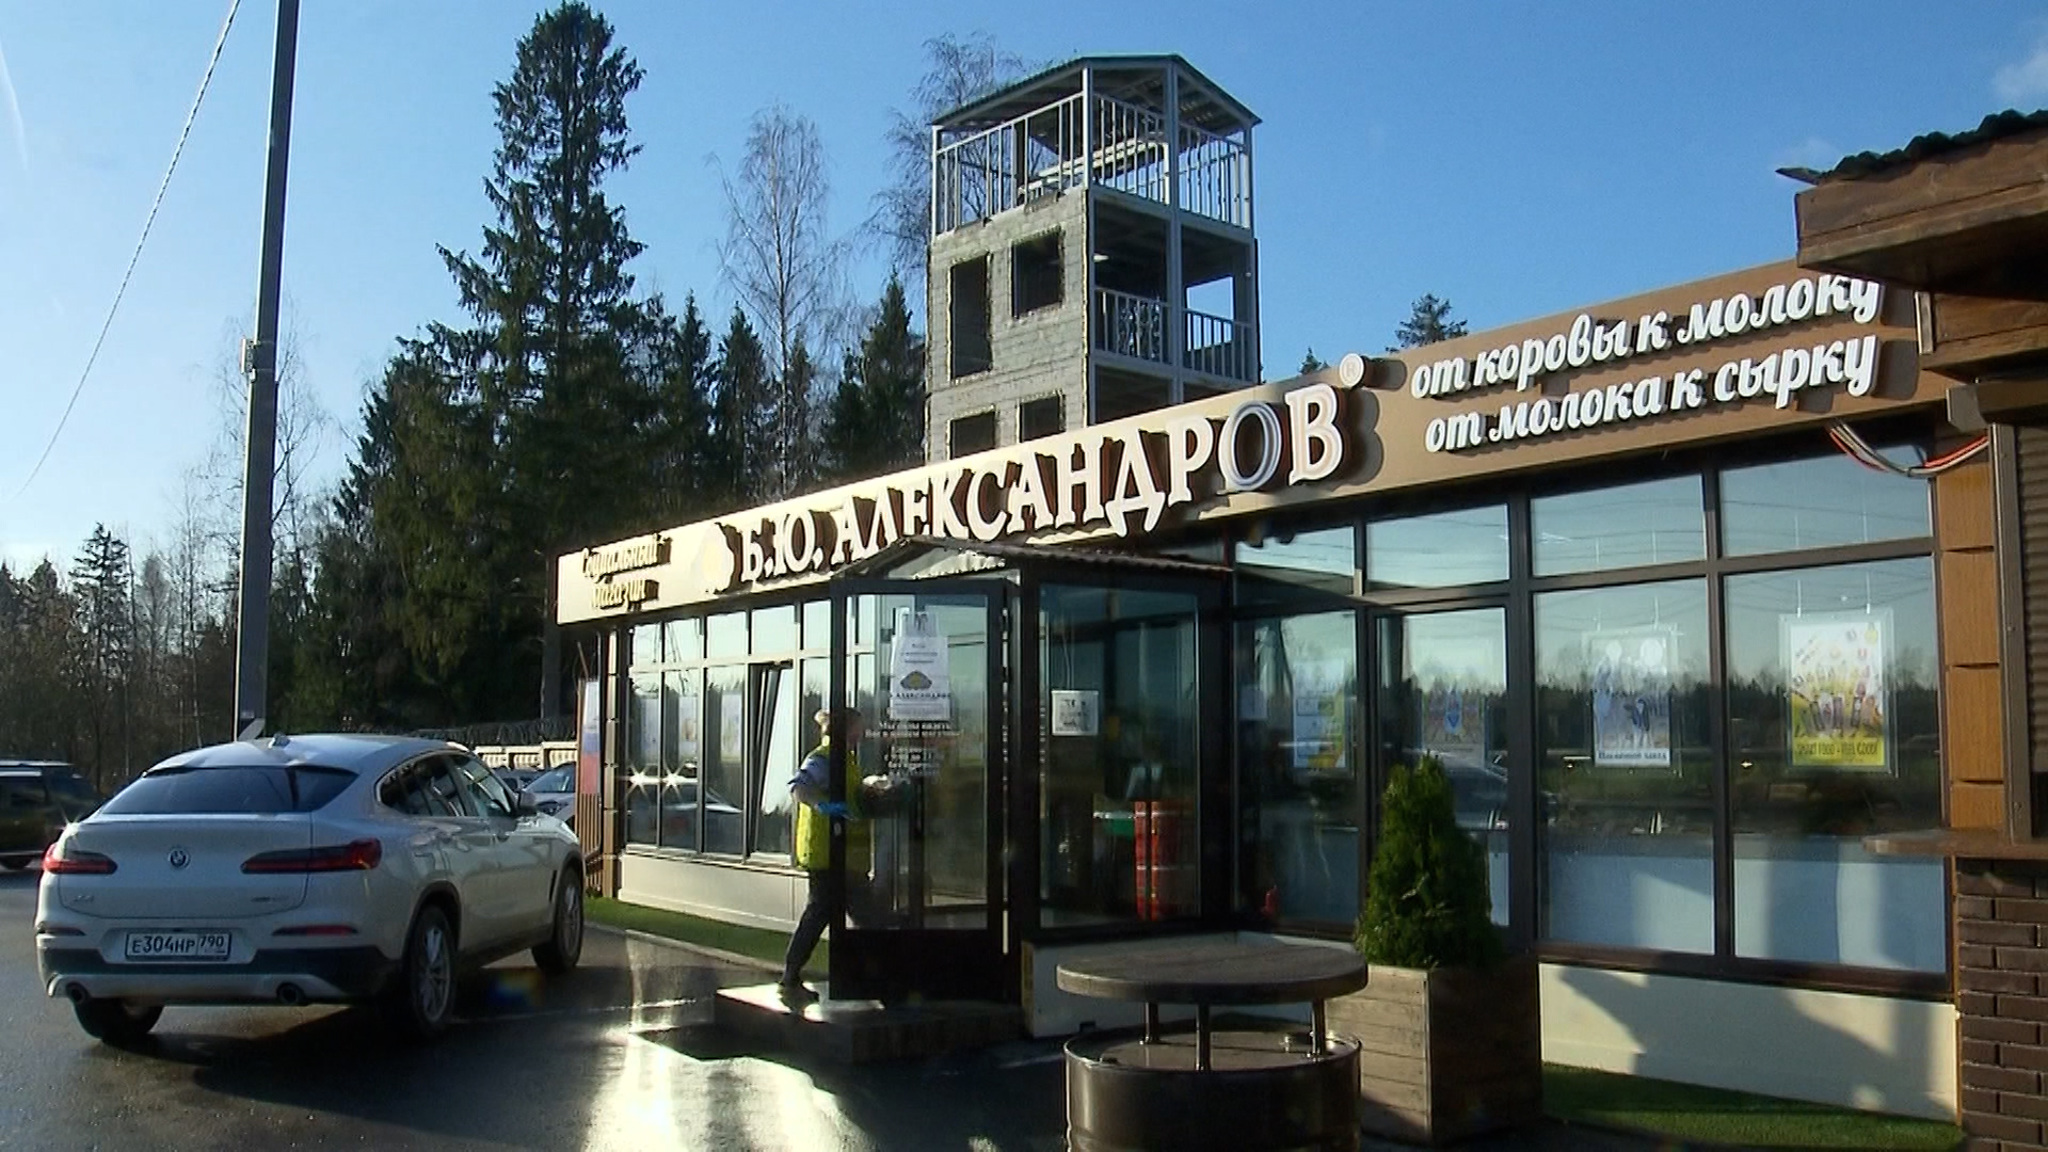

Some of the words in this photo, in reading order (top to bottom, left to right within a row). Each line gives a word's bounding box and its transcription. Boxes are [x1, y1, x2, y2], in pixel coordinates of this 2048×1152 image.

[1411, 357, 1467, 399] от
[1473, 313, 1629, 393] коровы
[1636, 310, 1669, 353] к
[1676, 274, 1880, 345] молоку
[1425, 411, 1482, 453] от
[1488, 376, 1664, 443] молока
[1670, 368, 1704, 411] к
[1714, 334, 1877, 410] сырку
[741, 511, 824, 582] Б.Ю.
[831, 382, 1343, 565] АЛЕКСАНДРОВ
[200, 935, 225, 947] 790
